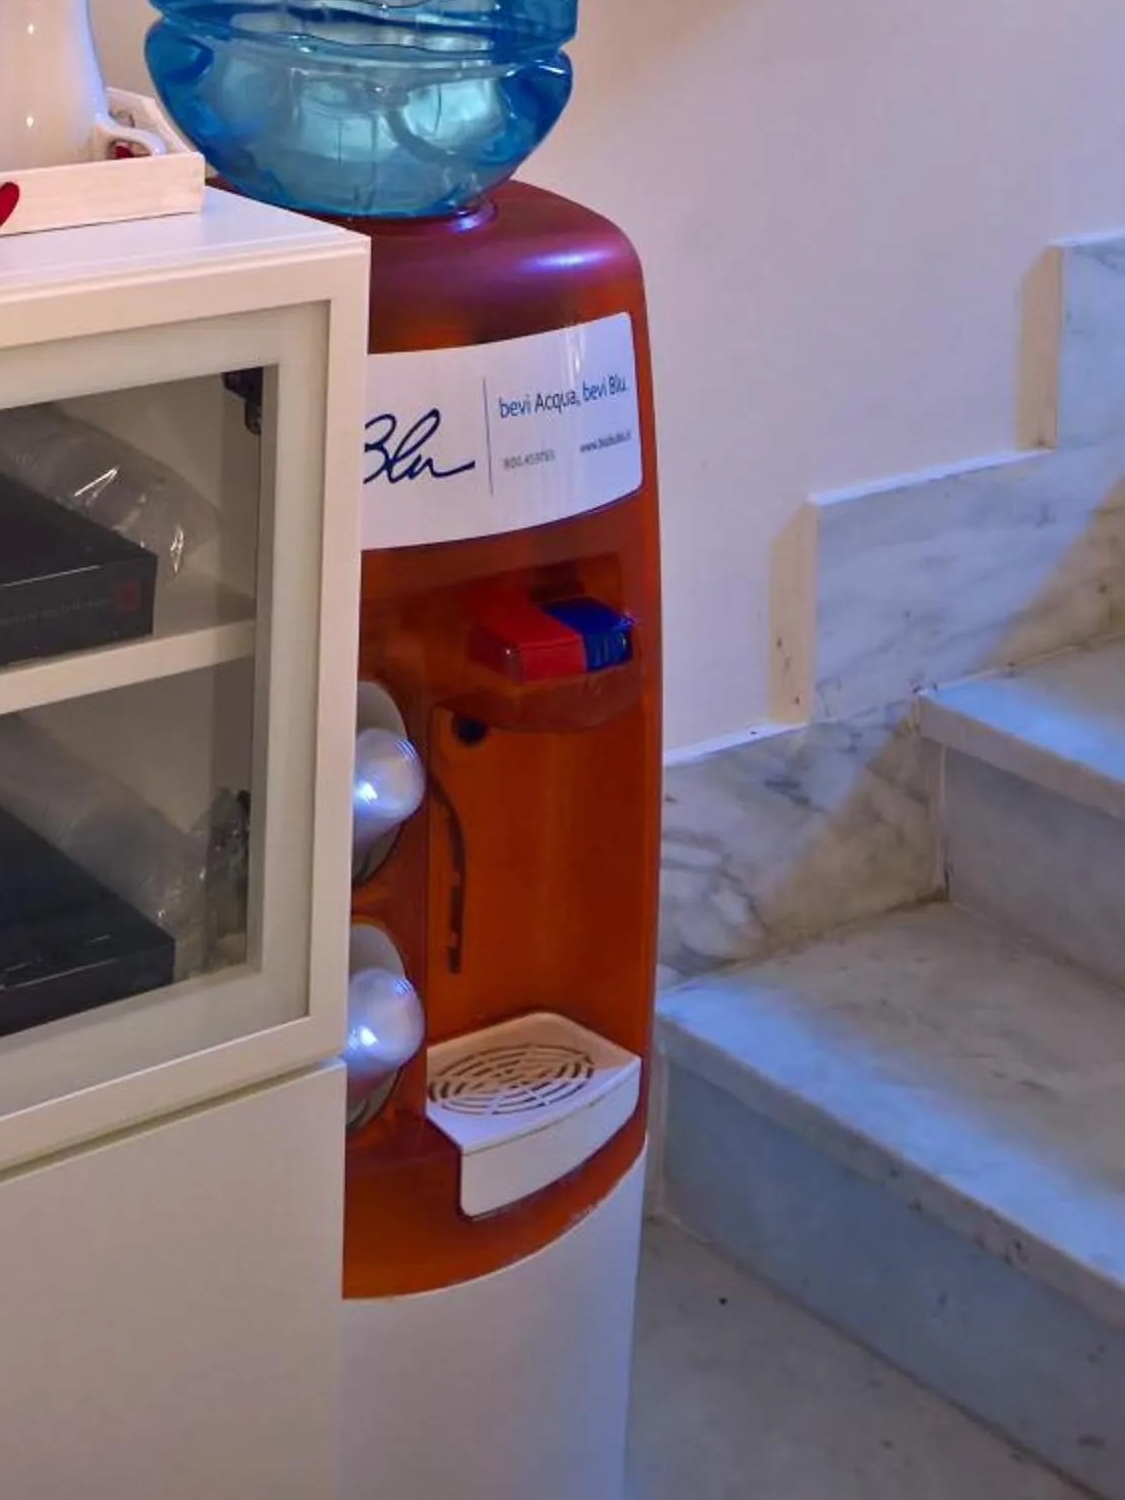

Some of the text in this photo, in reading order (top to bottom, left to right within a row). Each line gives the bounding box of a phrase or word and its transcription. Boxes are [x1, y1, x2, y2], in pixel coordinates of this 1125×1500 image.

[498, 394, 531, 418] bevi
[535, 390, 581, 413] Acqua,
[582, 378, 607, 401] bevi
